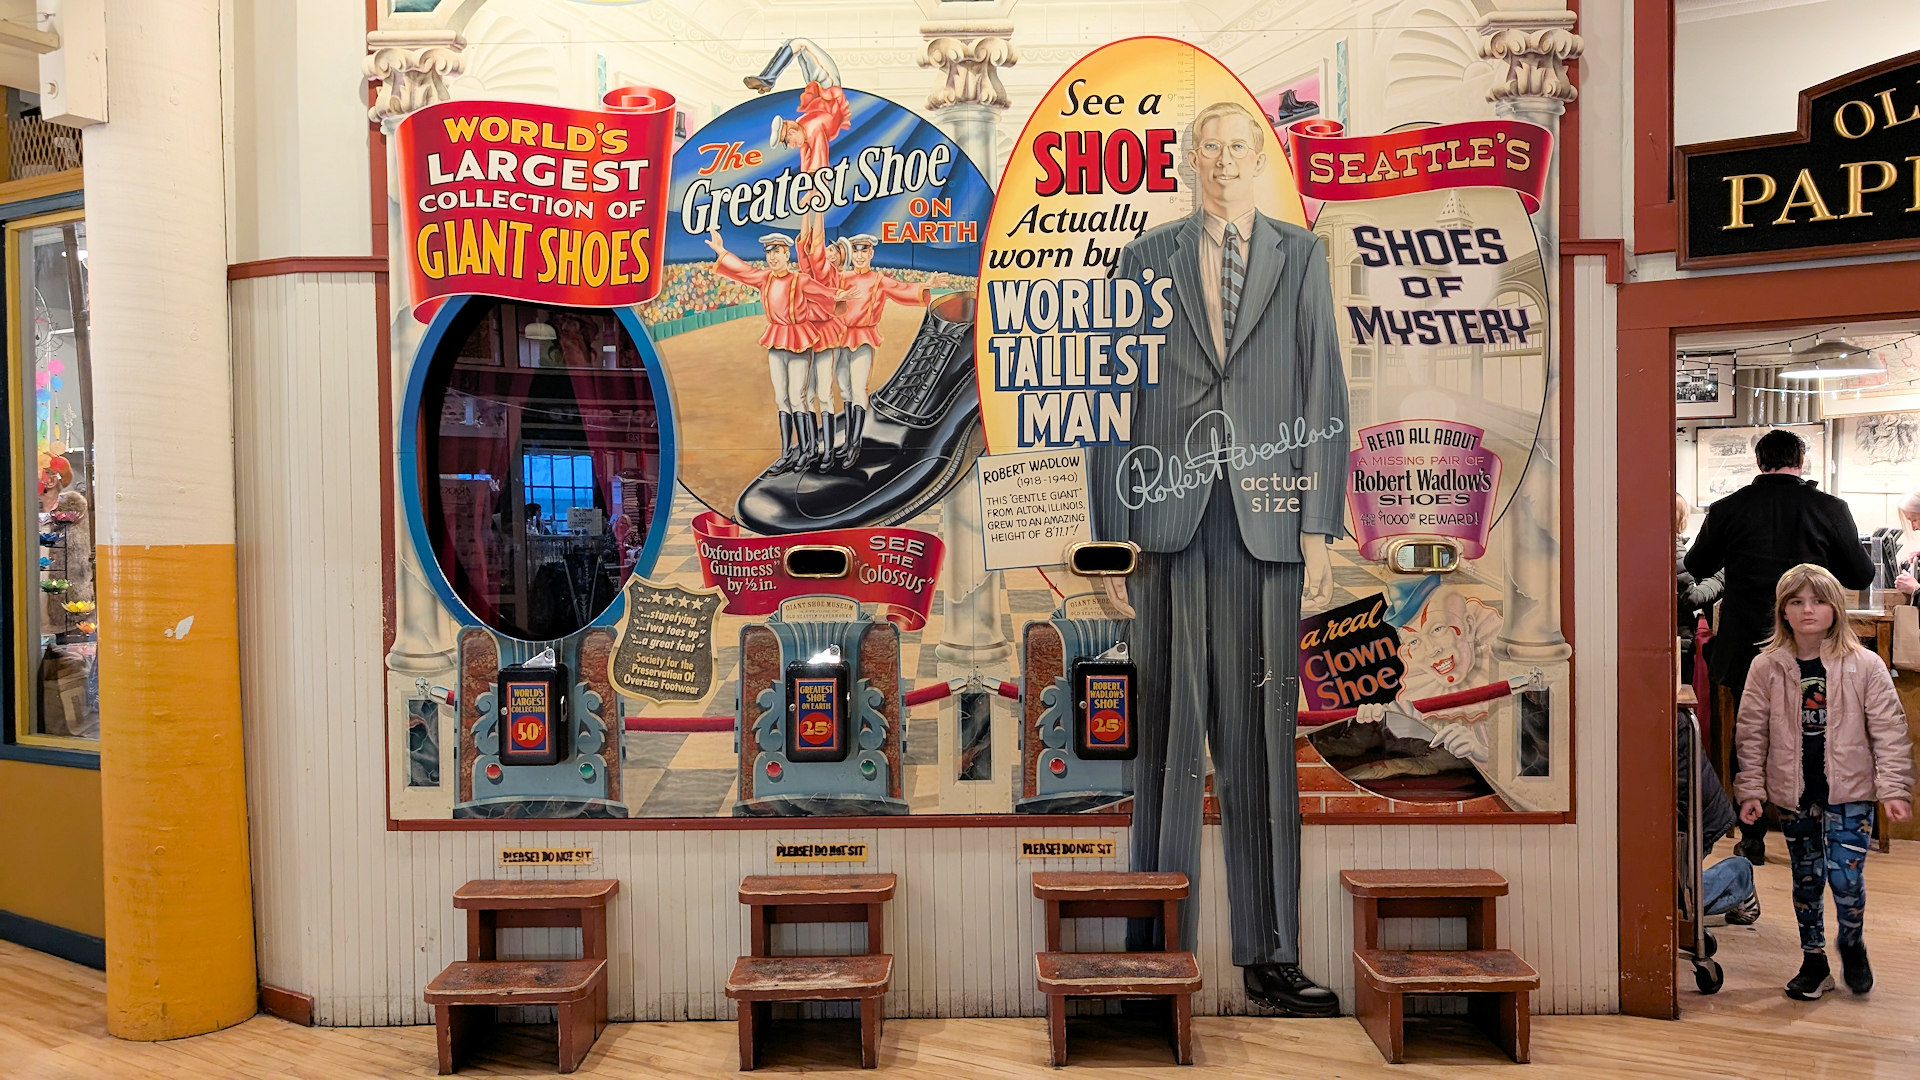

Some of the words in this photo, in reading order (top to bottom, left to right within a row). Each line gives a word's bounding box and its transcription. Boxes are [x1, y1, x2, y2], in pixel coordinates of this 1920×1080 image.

[1061, 78, 1125, 116] See
[1138, 92, 1162, 115] a
[1833, 80, 1920, 139] OL
[443, 116, 629, 155] WORLD'S
[698, 141, 763, 176] The
[1032, 128, 1178, 197] SHOE
[1309, 132, 1531, 185] SEATTLE'S
[427, 149, 649, 193] LARGEST
[681, 157, 850, 235] Greatest
[852, 143, 951, 204] Shoe
[418, 188, 595, 220] COLLECTION
[607, 199, 646, 220] OF
[908, 197, 951, 218] ON
[1006, 203, 1149, 237] Actually
[881, 220, 978, 244] EARTH
[417, 218, 533, 280] GIANT
[537, 226, 651, 288] SHOES
[1352, 224, 1510, 267] SHOES
[989, 247, 1074, 269] worn
[1083, 238, 1121, 280] by
[1398, 276, 1465, 299] OF
[987, 267, 1175, 335] WORLD'S
[1346, 305, 1531, 346] MYSTERY
[988, 333, 1167, 391] TALLEST
[1017, 390, 1132, 448] MAN
[1366, 429, 1405, 452] READ
[1409, 427, 1431, 444] ALL
[1434, 428, 1480, 451] ABOUT
[983, 462, 1026, 485] ROBERT
[1029, 456, 1080, 472] WADLOW
[1116, 427, 1226, 510] Robert
[1357, 457, 1367, 466] A
[1372, 456, 1425, 466] MISSING
[1431, 456, 1460, 466] PAIR
[1465, 456, 1485, 466] OF
[1240, 471, 1318, 491] actual
[1353, 469, 1412, 493] Robert
[1416, 467, 1492, 493] Wadlow's
[986, 495, 1008, 506] THIS
[1251, 493, 1300, 513] size
[1378, 493, 1471, 506] SHOES
[987, 507, 1014, 518] FROM
[1016, 505, 1047, 516] ALTON,
[1419, 512, 1480, 527] REWARD!
[988, 520, 1014, 531] GREW
[1016, 519, 1028, 527] TO
[1029, 518, 1042, 527] AN
[1044, 513, 1086, 525] AMAZING
[869, 535, 925, 556] SEE
[991, 531, 1026, 542] HEIGHT
[1028, 530, 1041, 539] OF
[745, 545, 782, 562] beats
[877, 552, 914, 570] THE
[727, 577, 743, 596] by
[759, 577, 778, 592] in.
[827, 601, 854, 610] MUSEUM
[1070, 599, 1091, 608] GIANT
[666, 624, 686, 637] toes
[1301, 628, 1321, 650] a
[1322, 600, 1383, 643] real
[650, 638, 675, 651] great
[635, 652, 666, 669] Society
[666, 656, 679, 668] for
[680, 658, 695, 671] the
[1304, 636, 1396, 682] Clown
[631, 663, 683, 681] Preservation
[684, 671, 696, 683] Of
[513, 688, 545, 697] WORLD'S
[623, 673, 660, 689] Oversize
[660, 680, 700, 695] Footwear
[799, 685, 833, 694] GREATEST
[1090, 689, 1124, 699] WADLOW'S
[1093, 681, 1121, 690] ROBERT
[1316, 666, 1400, 711] Shoe
[512, 697, 545, 706] LARGEST
[801, 702, 810, 710] ON
[811, 702, 831, 710] EARTH
[806, 693, 827, 702] SHOE
[1094, 698, 1120, 709] SHOE
[511, 705, 545, 713] COLLECTION
[503, 851, 540, 863] PLEASE!
[541, 851, 555, 862] DO
[556, 851, 574, 862] NOT
[776, 844, 813, 857] PLEASE!
[814, 845, 828, 856] DO
[829, 845, 848, 856] NOT
[848, 845, 866, 856] SIT
[1023, 843, 1060, 855] PLEASE!
[1061, 843, 1076, 855] DO
[1076, 843, 1096, 854] NOT
